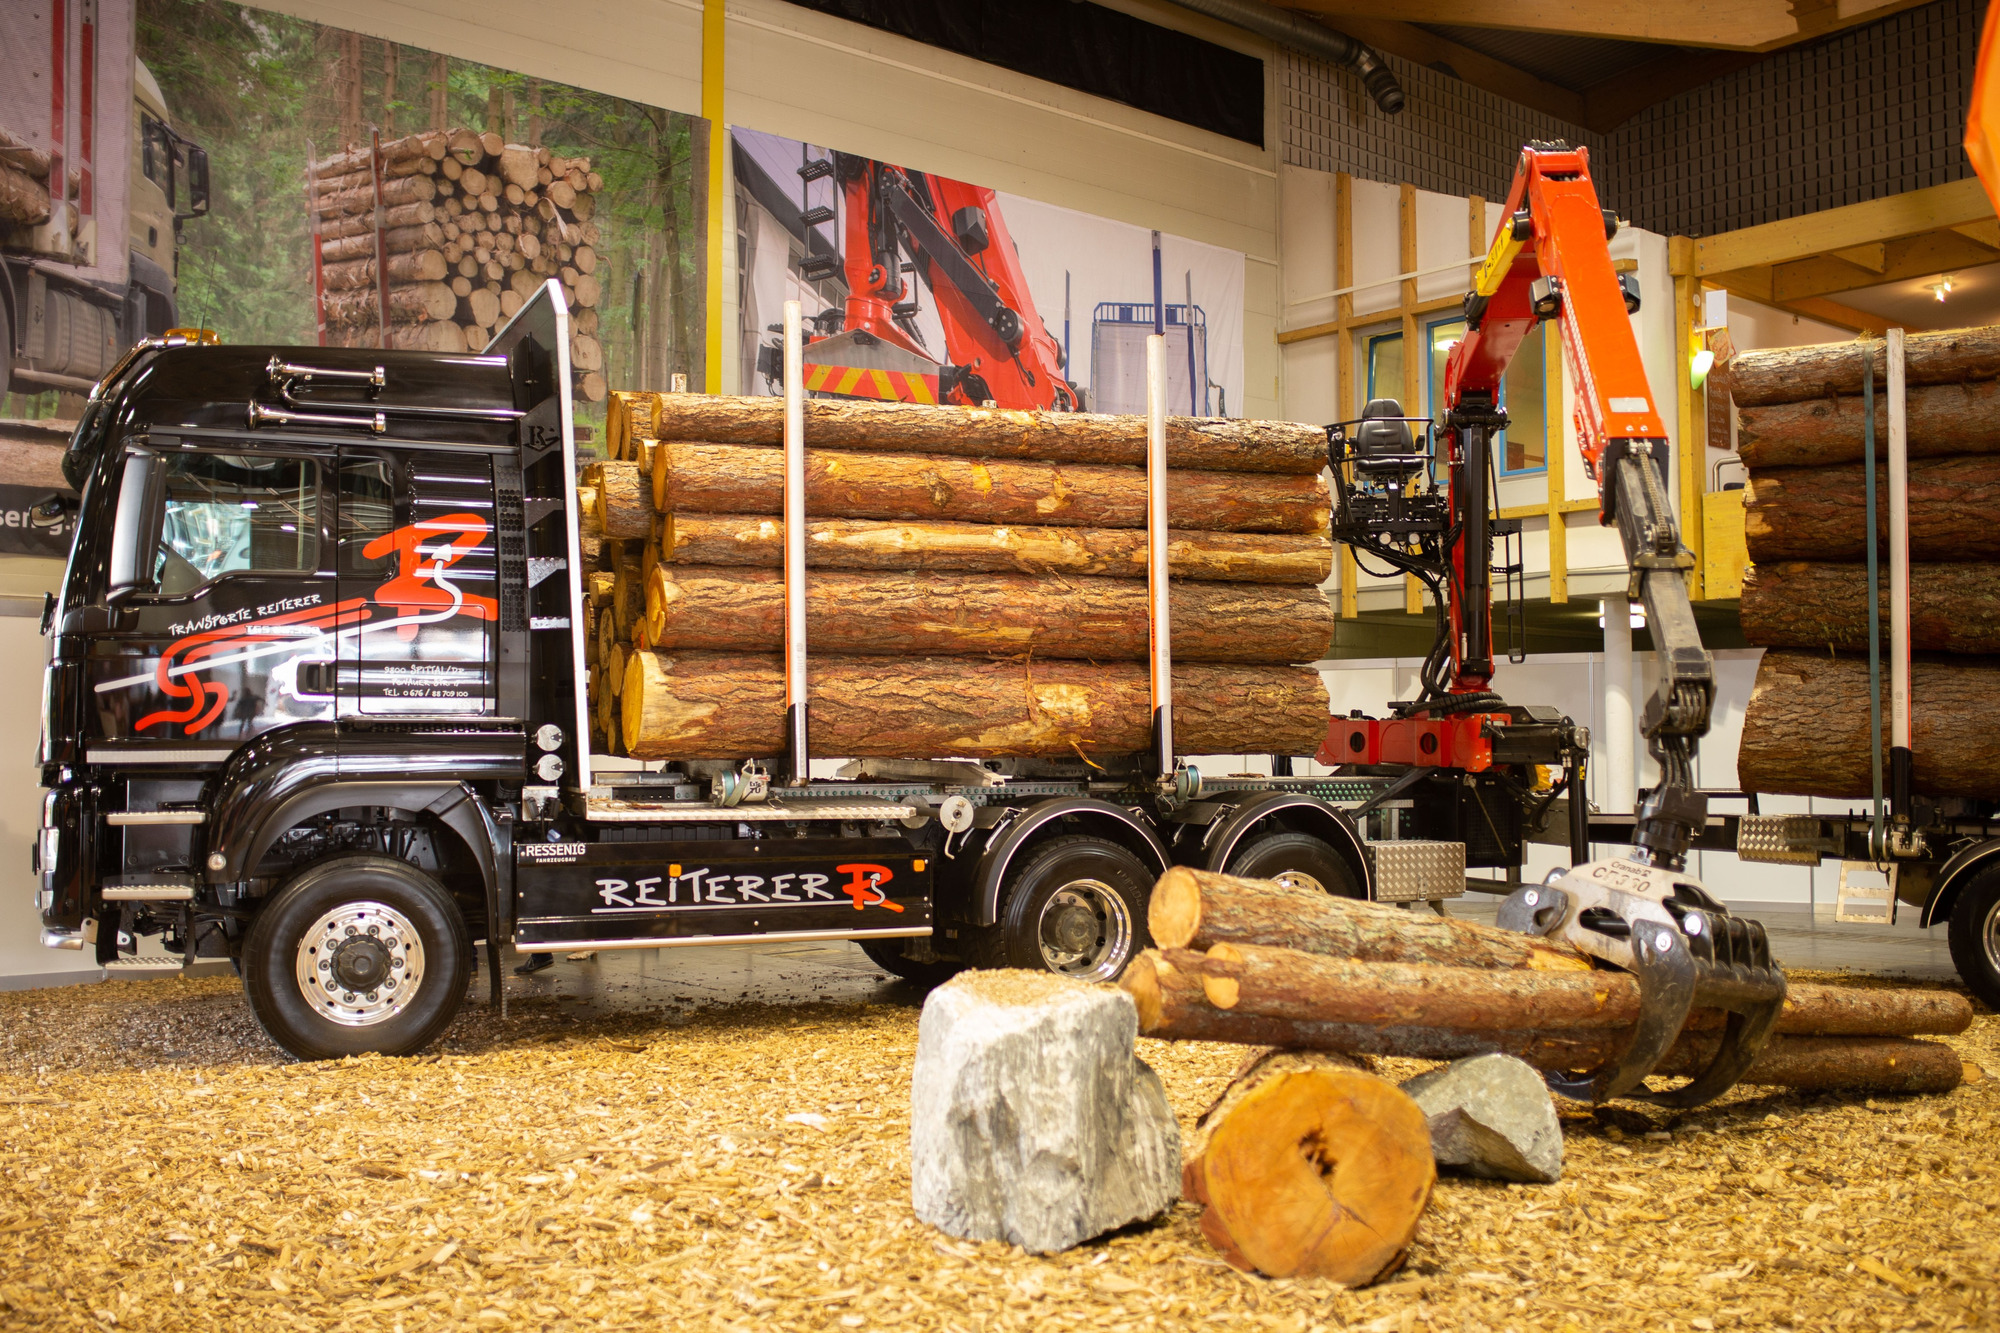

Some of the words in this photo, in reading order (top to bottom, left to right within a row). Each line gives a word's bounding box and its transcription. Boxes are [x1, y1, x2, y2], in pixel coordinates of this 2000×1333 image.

[168, 608, 252, 636] TRANSPORTE
[257, 594, 322, 616] REITERER
[383, 688, 400, 696] TEL.
[526, 844, 586, 857] RESSENIG
